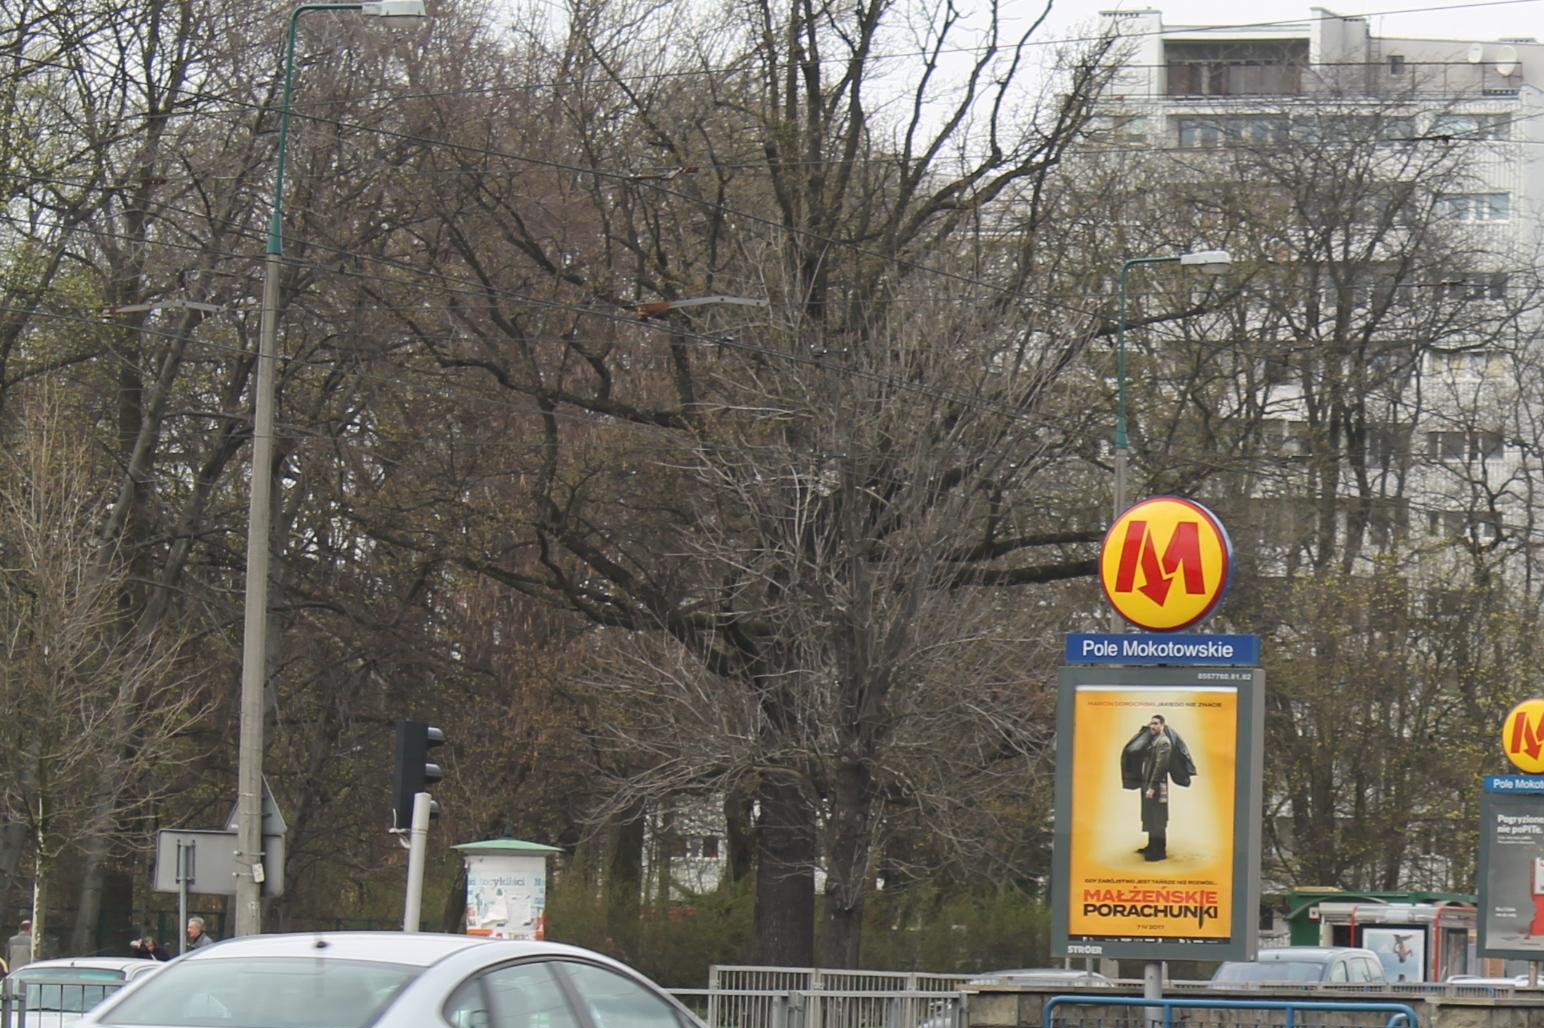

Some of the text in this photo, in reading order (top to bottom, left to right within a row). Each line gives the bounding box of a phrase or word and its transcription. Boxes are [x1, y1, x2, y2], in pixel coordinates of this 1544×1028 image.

[1082, 640, 1234, 657] Pole Mokotowskie
[1493, 778, 1513, 789] Pole
[1083, 886, 1218, 904] MAŁŻEŃSKIE
[1083, 904, 1218, 919] PORACHUNKI
